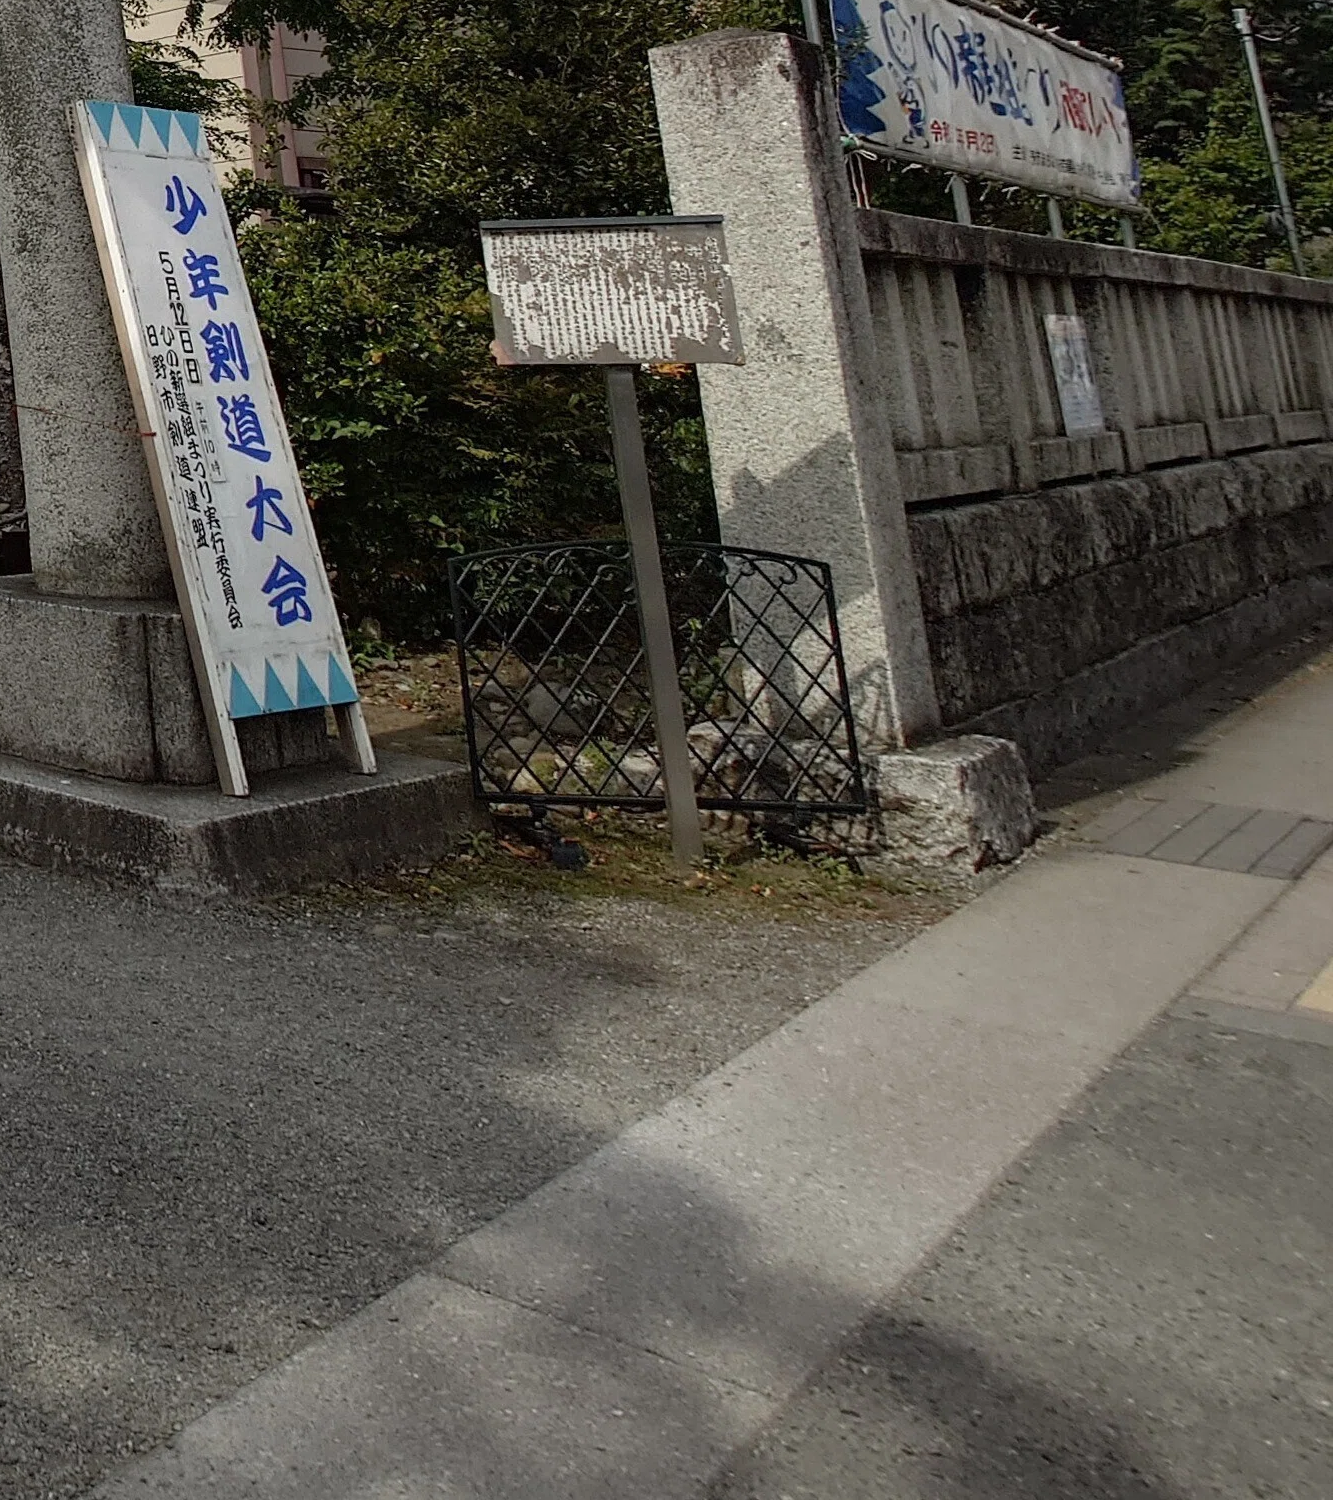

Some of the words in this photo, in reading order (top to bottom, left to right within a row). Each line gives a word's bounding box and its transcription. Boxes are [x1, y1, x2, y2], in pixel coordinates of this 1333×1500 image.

[163, 174, 313, 629] 少年剣道大会
